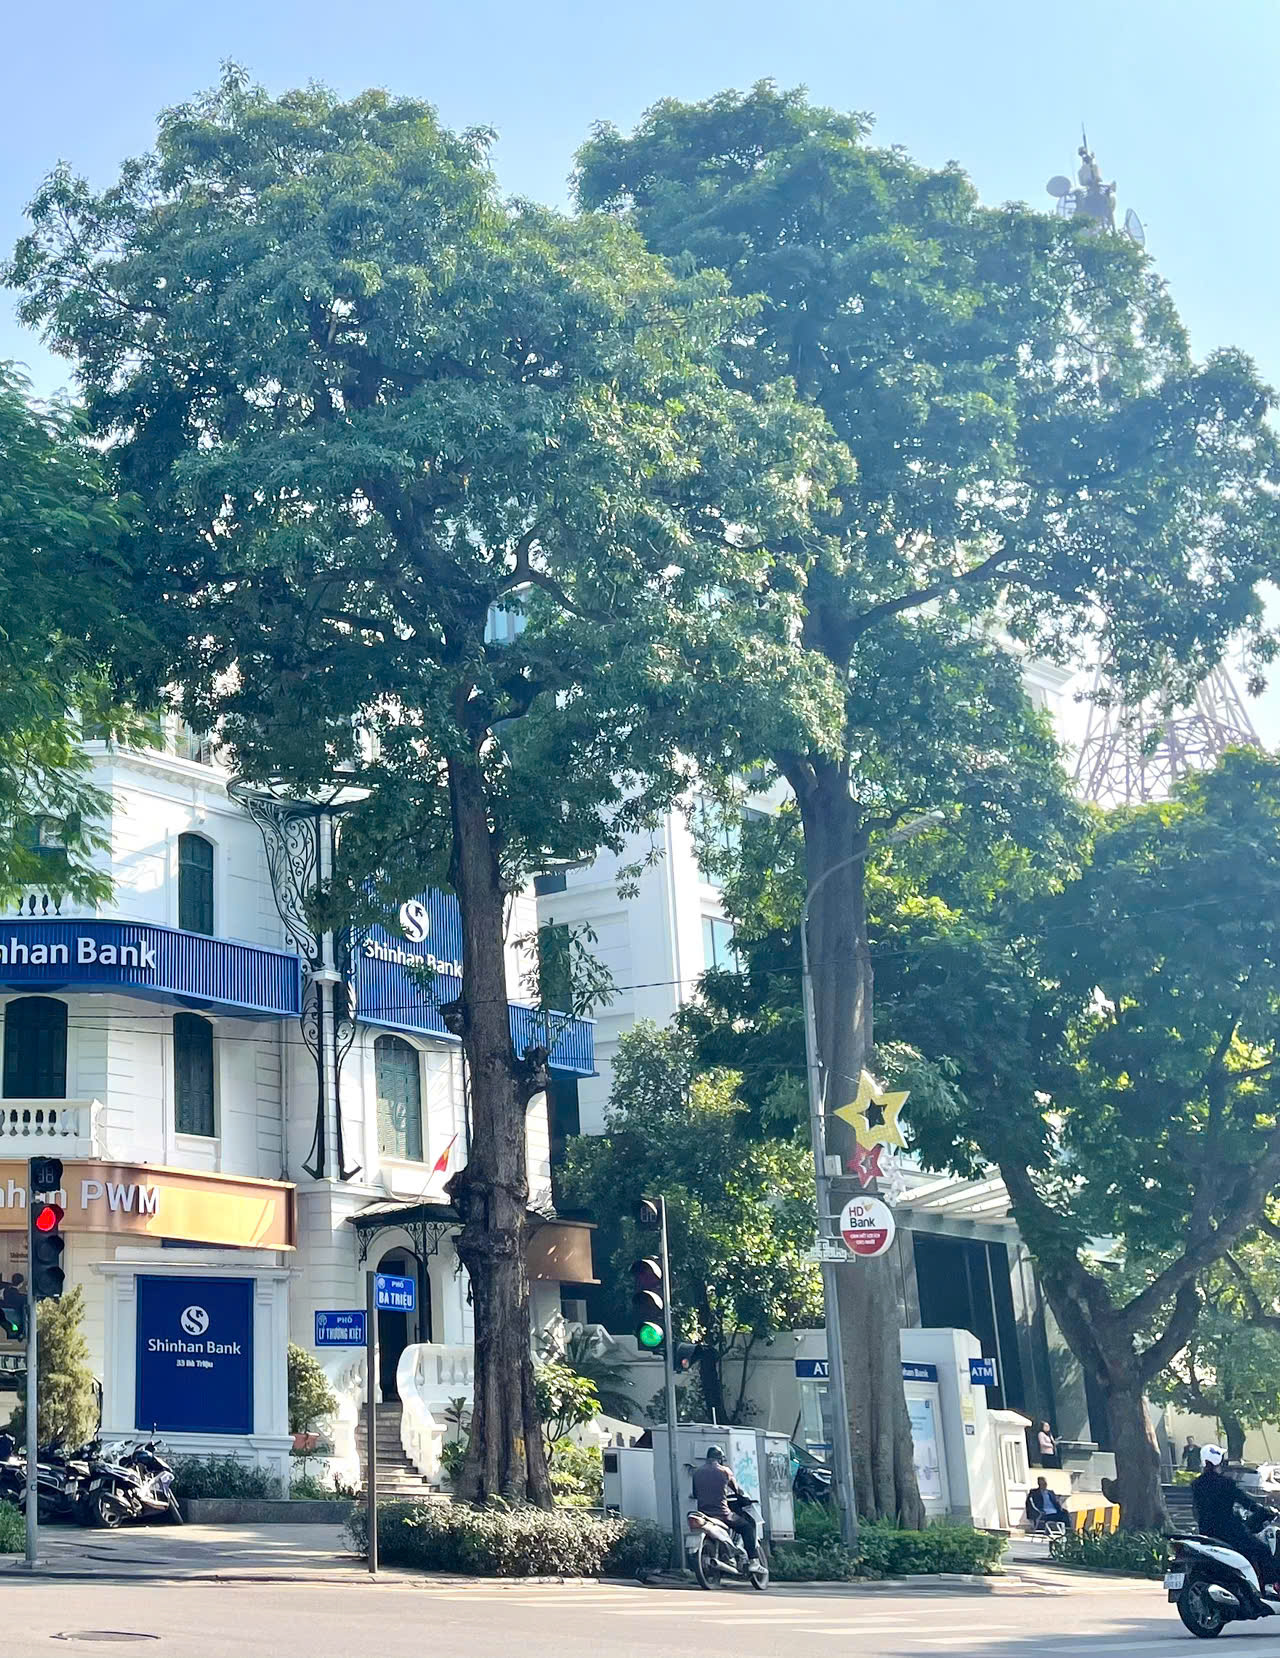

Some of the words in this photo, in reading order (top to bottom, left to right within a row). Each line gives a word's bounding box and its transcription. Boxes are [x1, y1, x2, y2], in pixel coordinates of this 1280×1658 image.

[77, 937, 157, 969] Bank
[364, 938, 424, 968] Shinhan
[81, 1180, 160, 1214] PWM
[848, 1206, 864, 1217] HD
[850, 1217, 876, 1228] Bank
[378, 1289, 389, 1304] BÀ
[148, 1338, 204, 1353] Shinhan
[206, 1340, 241, 1355] Bank
[813, 1362, 829, 1376] AT
[971, 1367, 993, 1377] ATM
